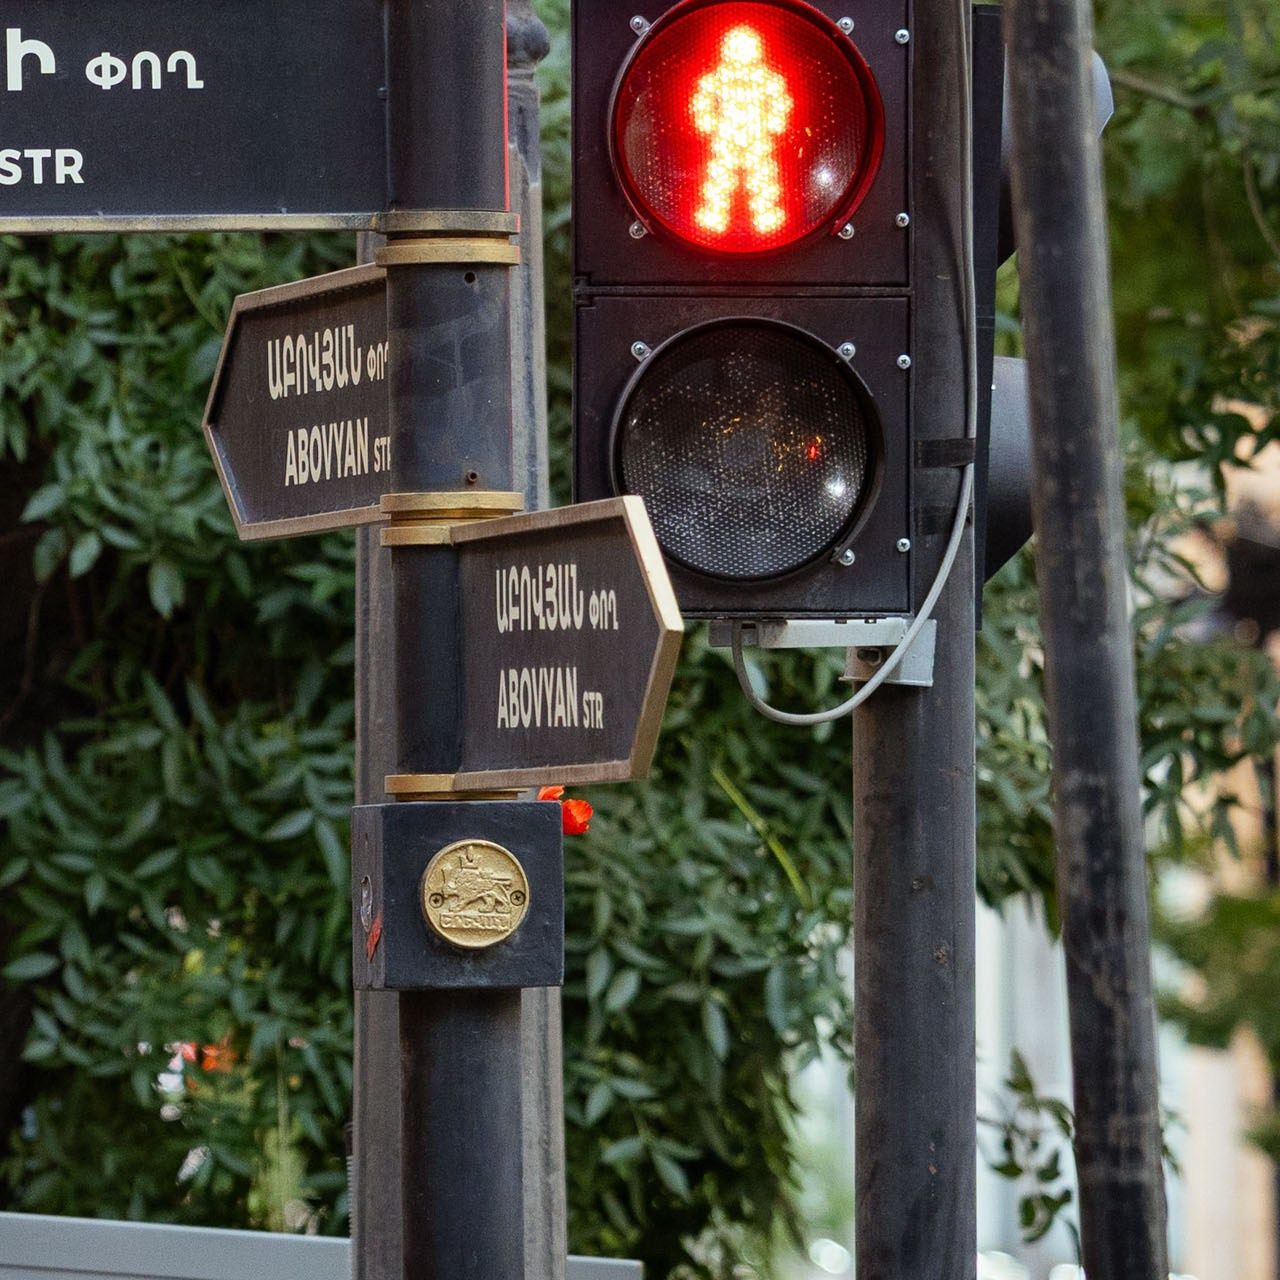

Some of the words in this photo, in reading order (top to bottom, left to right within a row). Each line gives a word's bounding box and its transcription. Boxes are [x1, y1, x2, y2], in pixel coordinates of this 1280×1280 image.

[267, 324, 363, 401] ԱԲՈՎՅԱՆ
[284, 416, 370, 487] ABOVYAN
[495, 563, 585, 634] ԱԲՈՎՅԱՆ
[497, 666, 579, 730] ABOVYAN
[582, 690, 604, 730] STR
